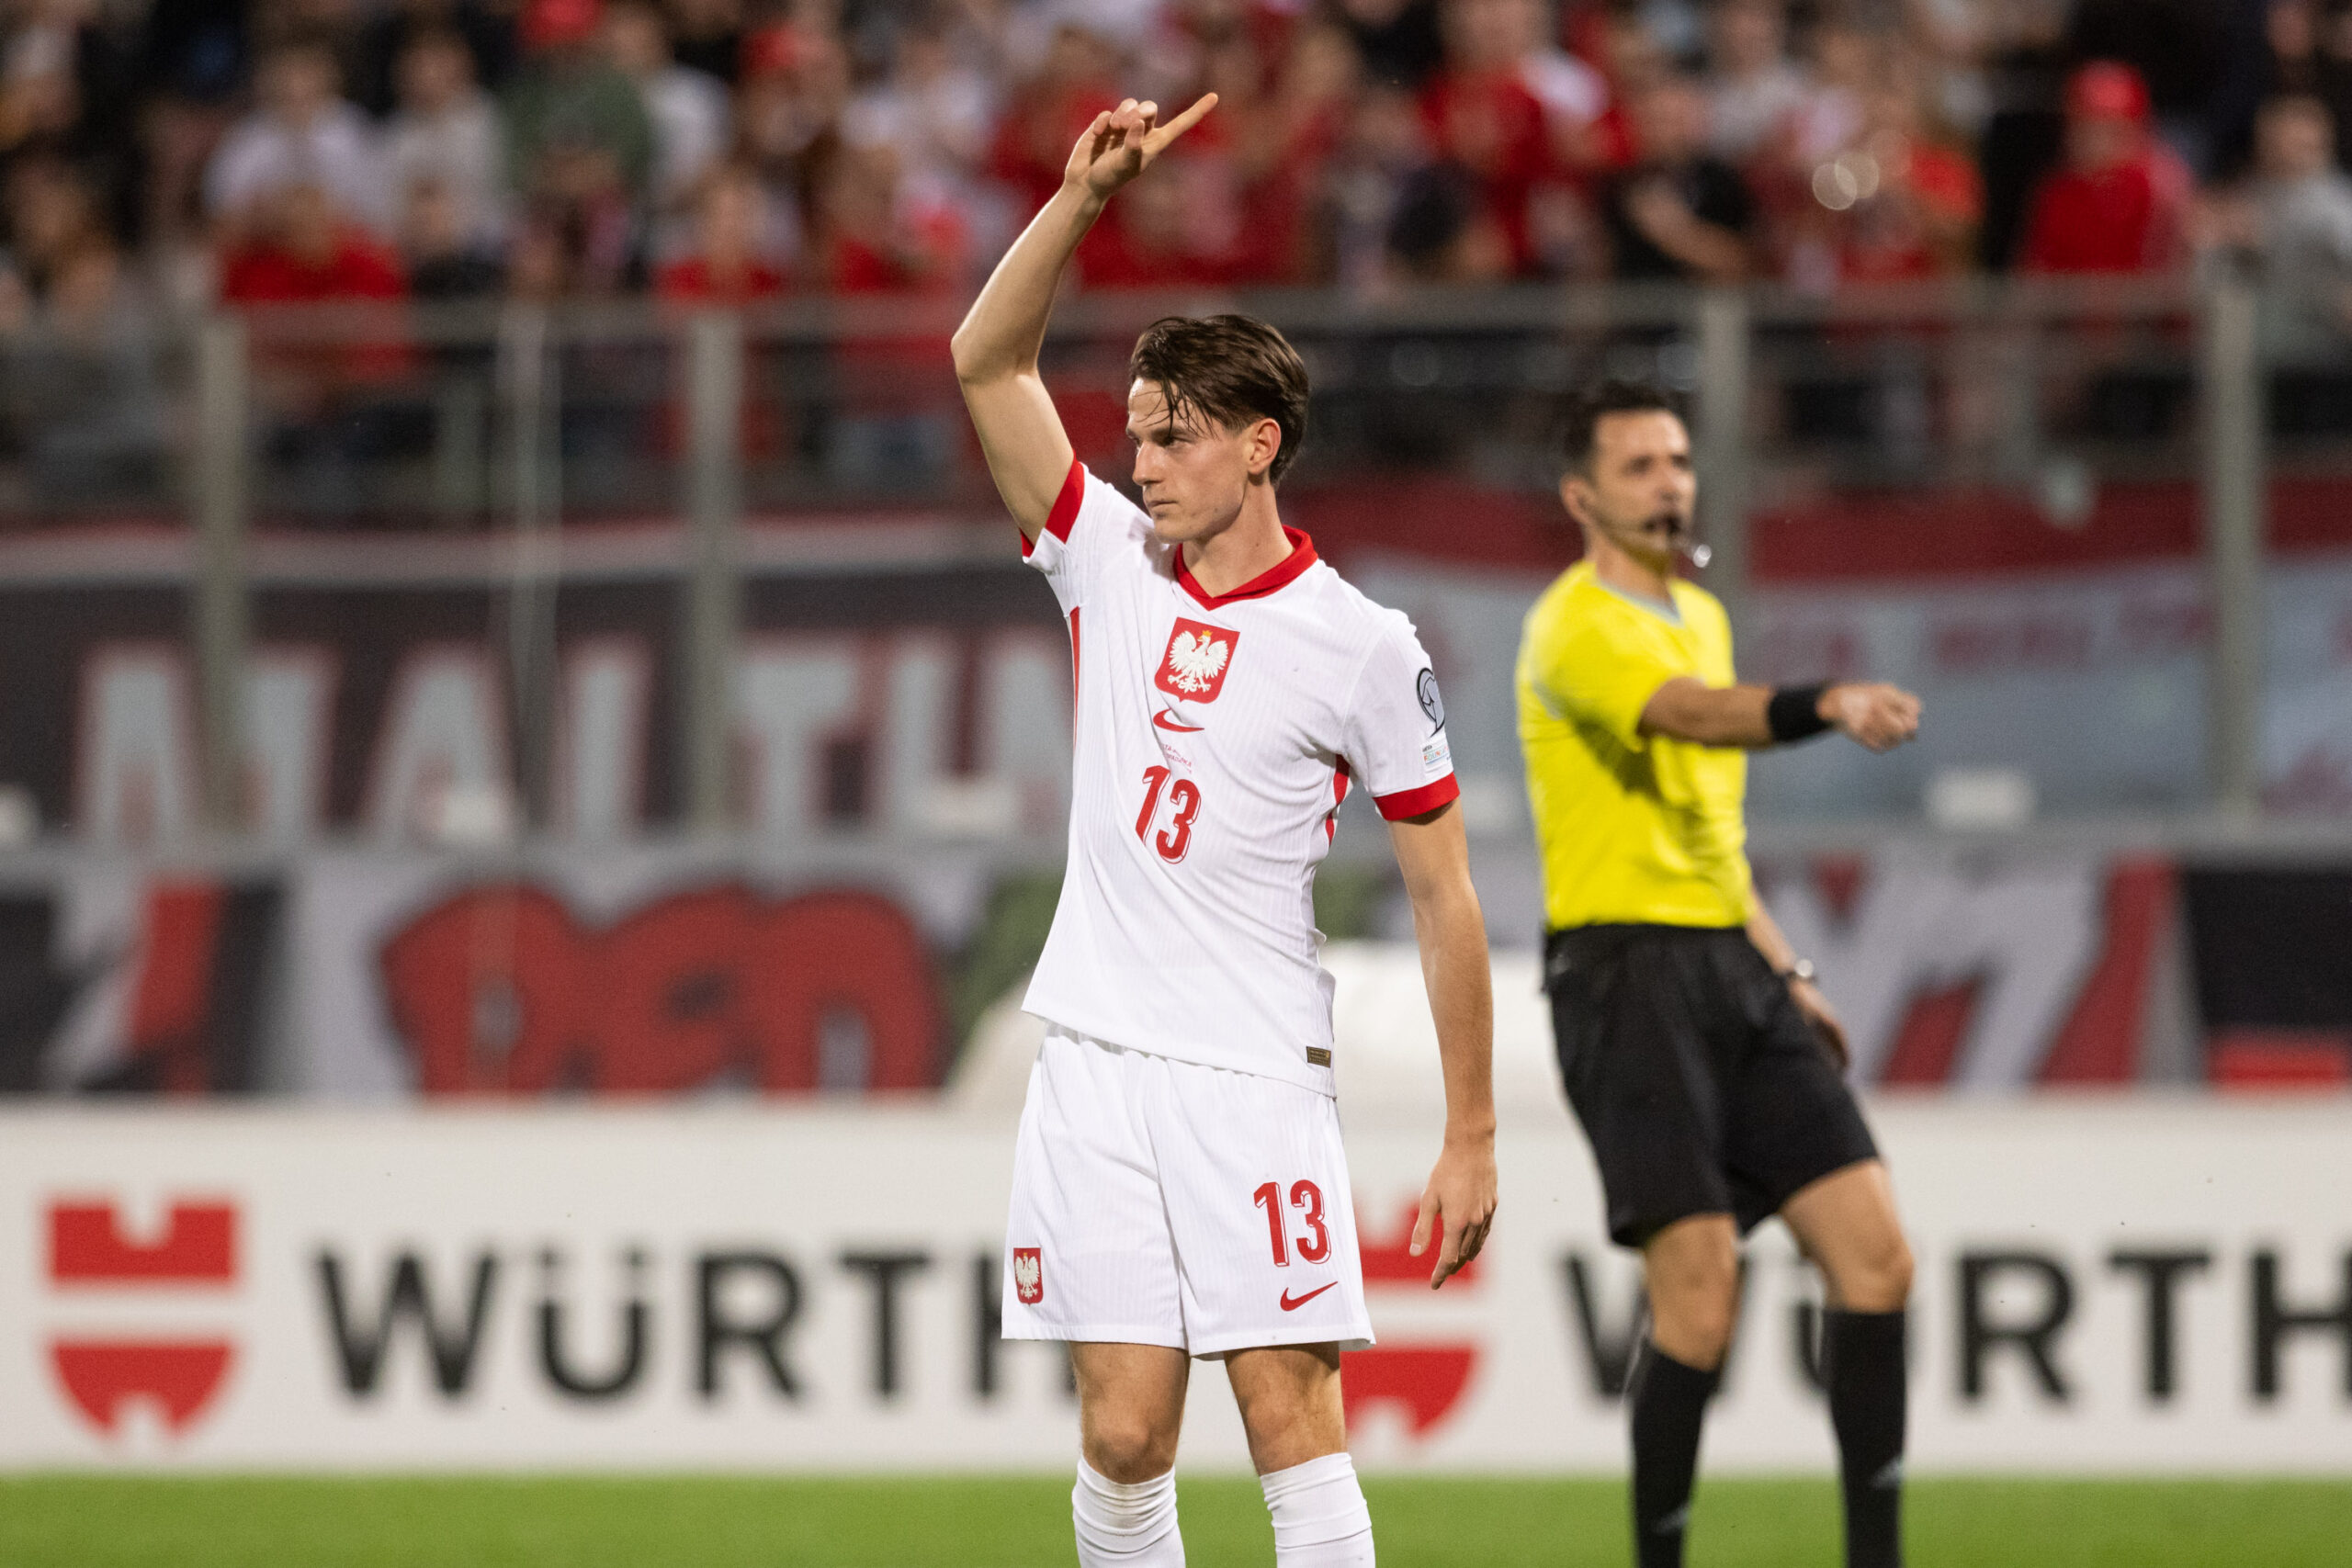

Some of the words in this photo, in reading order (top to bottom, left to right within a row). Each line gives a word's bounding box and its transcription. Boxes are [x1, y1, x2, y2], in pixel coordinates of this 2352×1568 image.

[1135, 764, 1202, 864] 13
[1252, 1179, 1332, 1268] 13
[1562, 1247, 2352, 1404] WRTH
